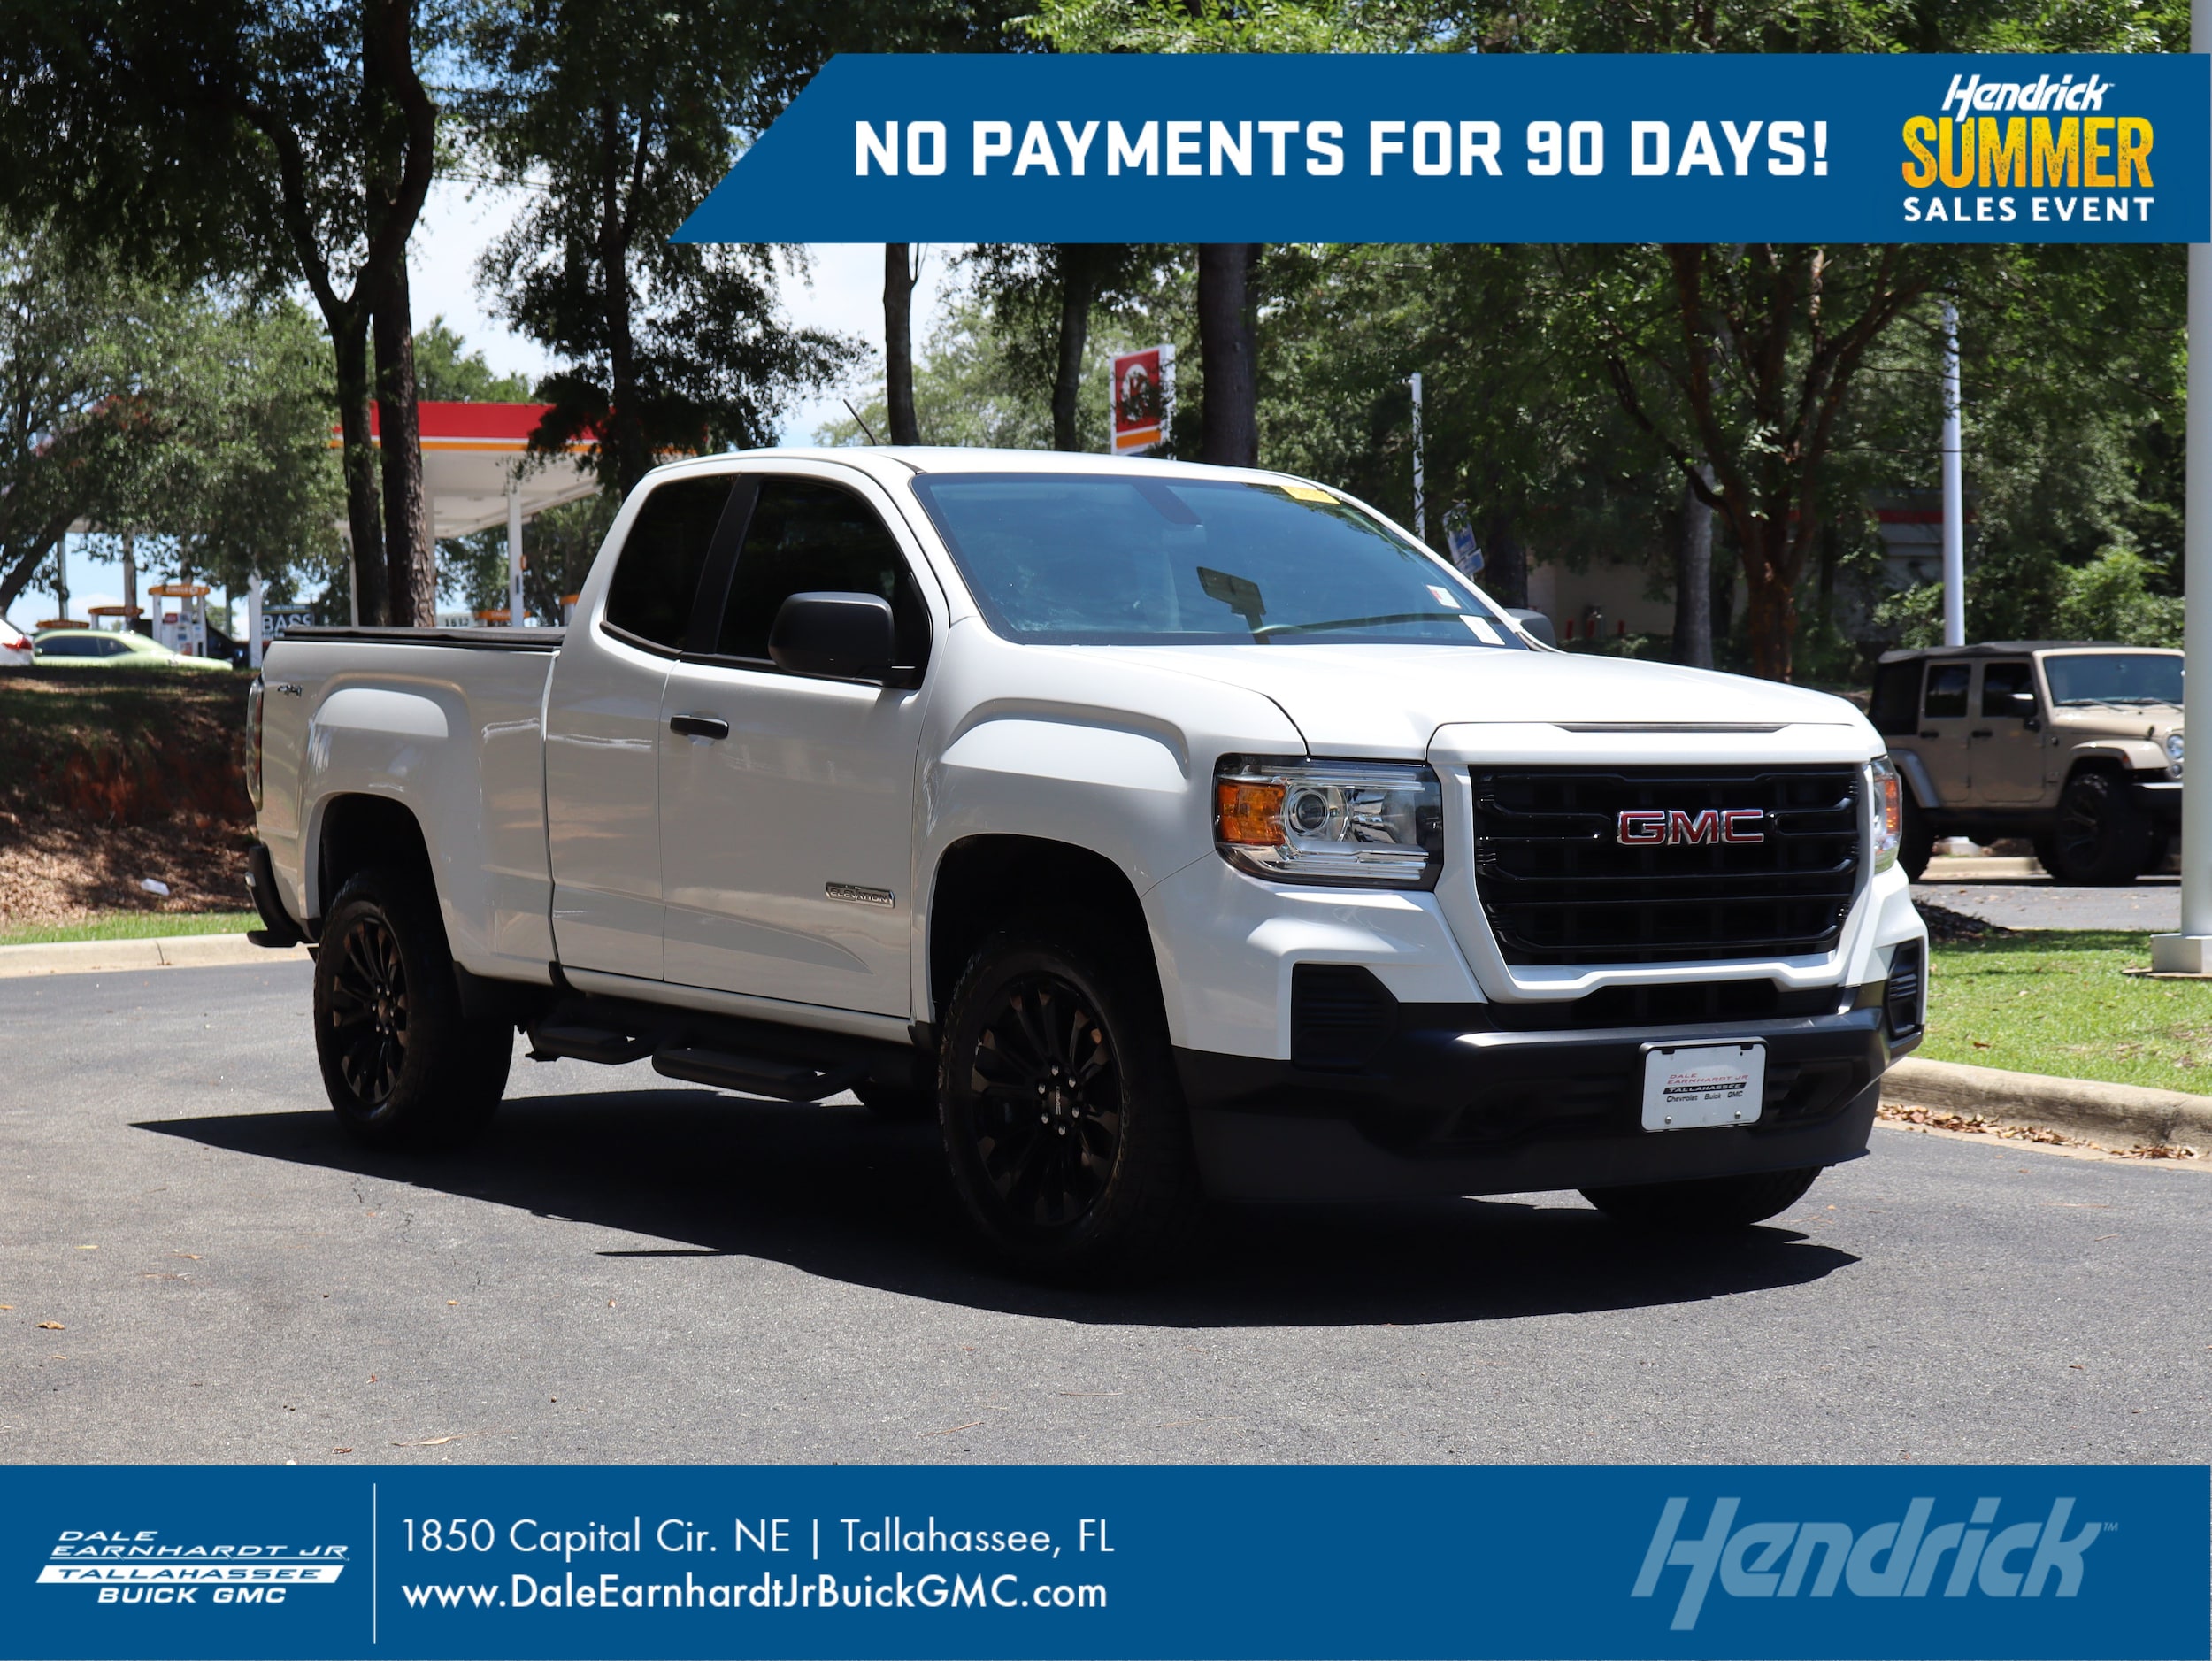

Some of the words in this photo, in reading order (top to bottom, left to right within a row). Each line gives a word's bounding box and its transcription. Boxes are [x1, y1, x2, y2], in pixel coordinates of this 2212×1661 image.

[1617, 809, 1764, 846] GMC
[829, 888, 888, 904] ELEVATION
[1667, 1076, 1732, 1085] EARNHARDT
[1669, 1082, 1742, 1093] TALLAHASSEE
